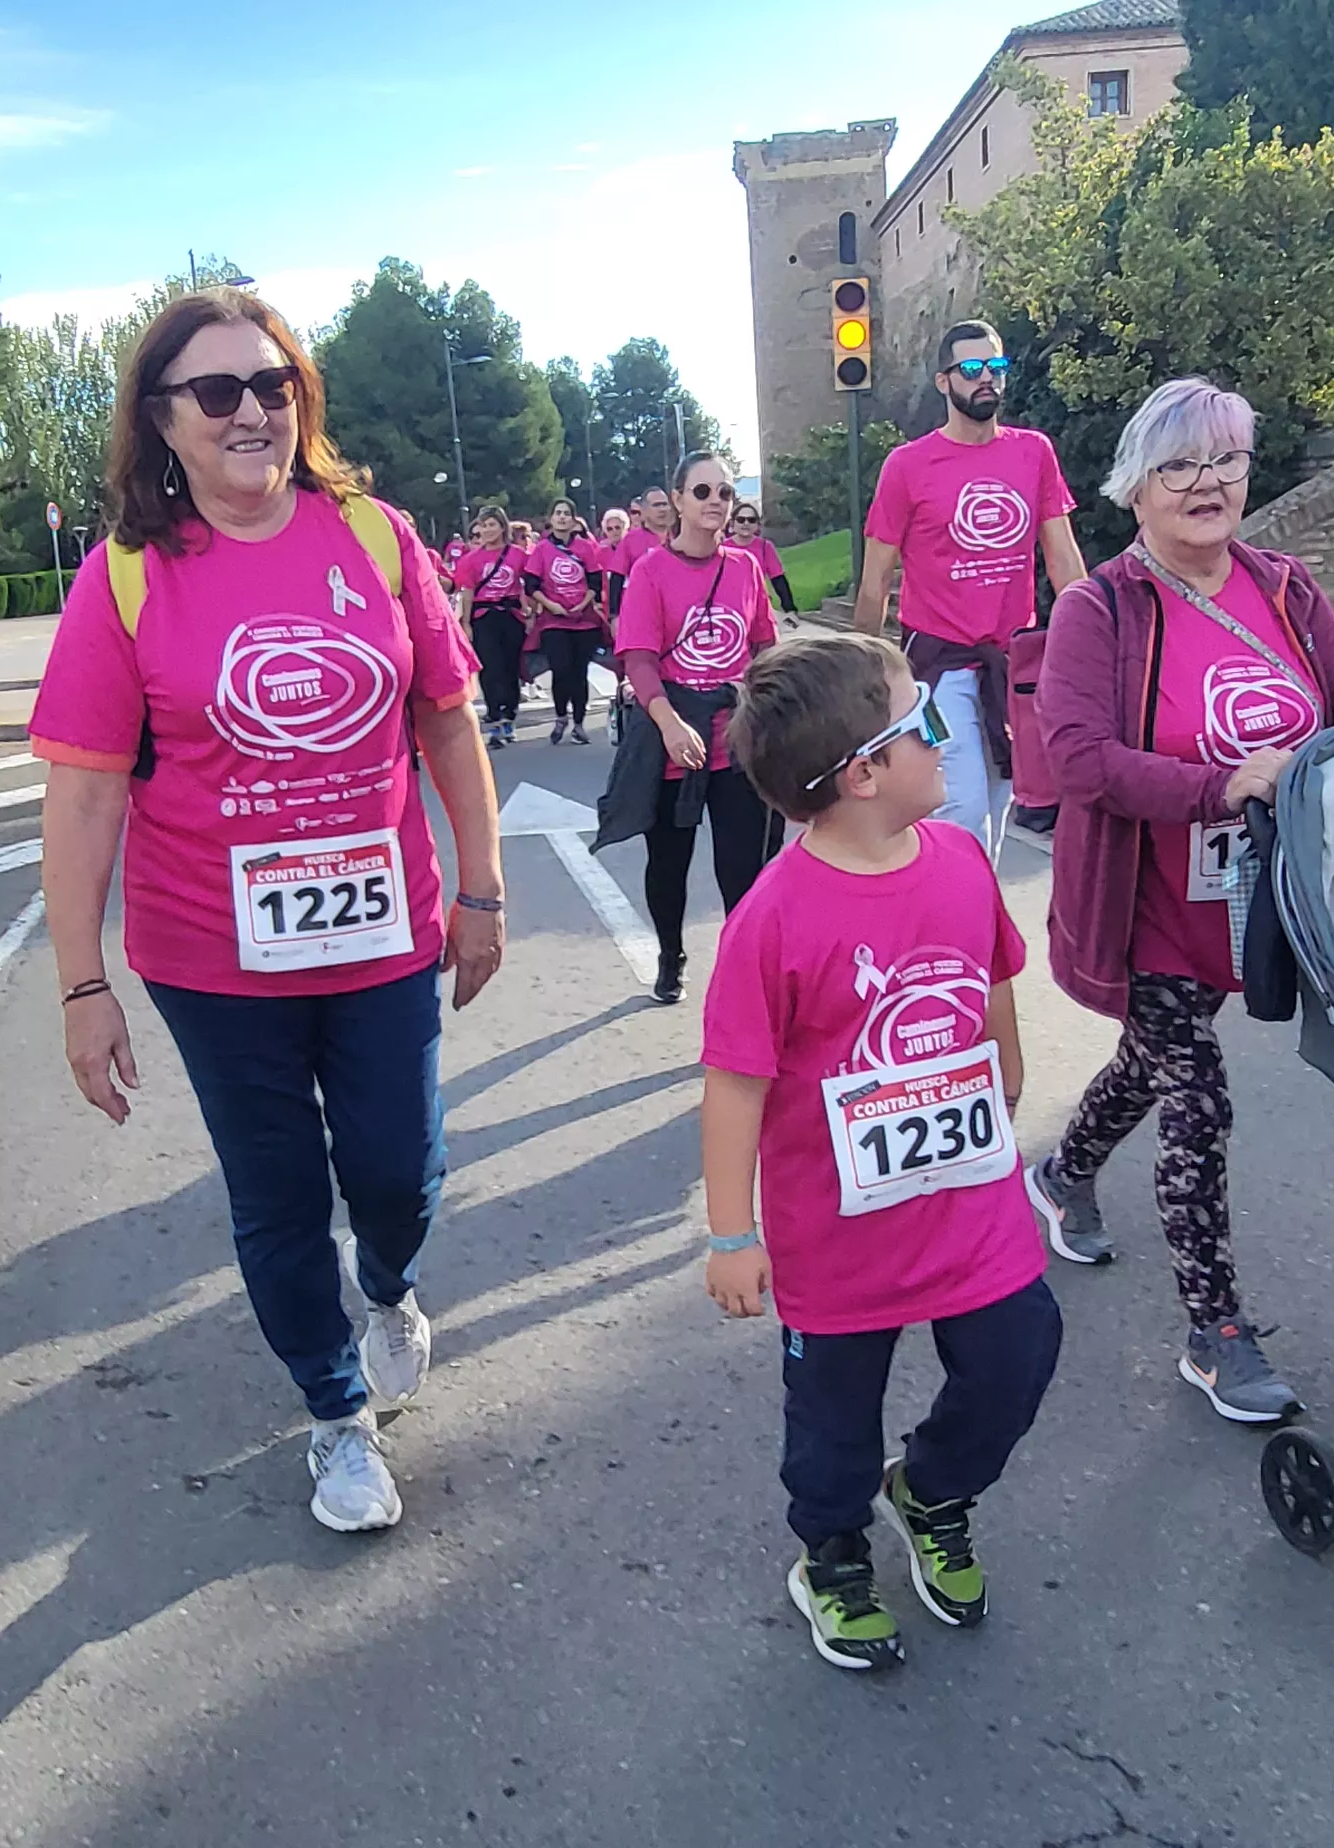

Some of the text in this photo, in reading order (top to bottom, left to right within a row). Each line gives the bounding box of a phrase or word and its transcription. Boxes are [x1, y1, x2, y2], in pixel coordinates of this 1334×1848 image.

[270, 681, 322, 703] JUNTOS
[256, 855, 386, 883] CONTRA EL CÁNCER
[257, 876, 390, 935] 1225
[853, 1074, 989, 1119] CONTRA EL CÁNCER
[858, 1098, 993, 1177] 1230
